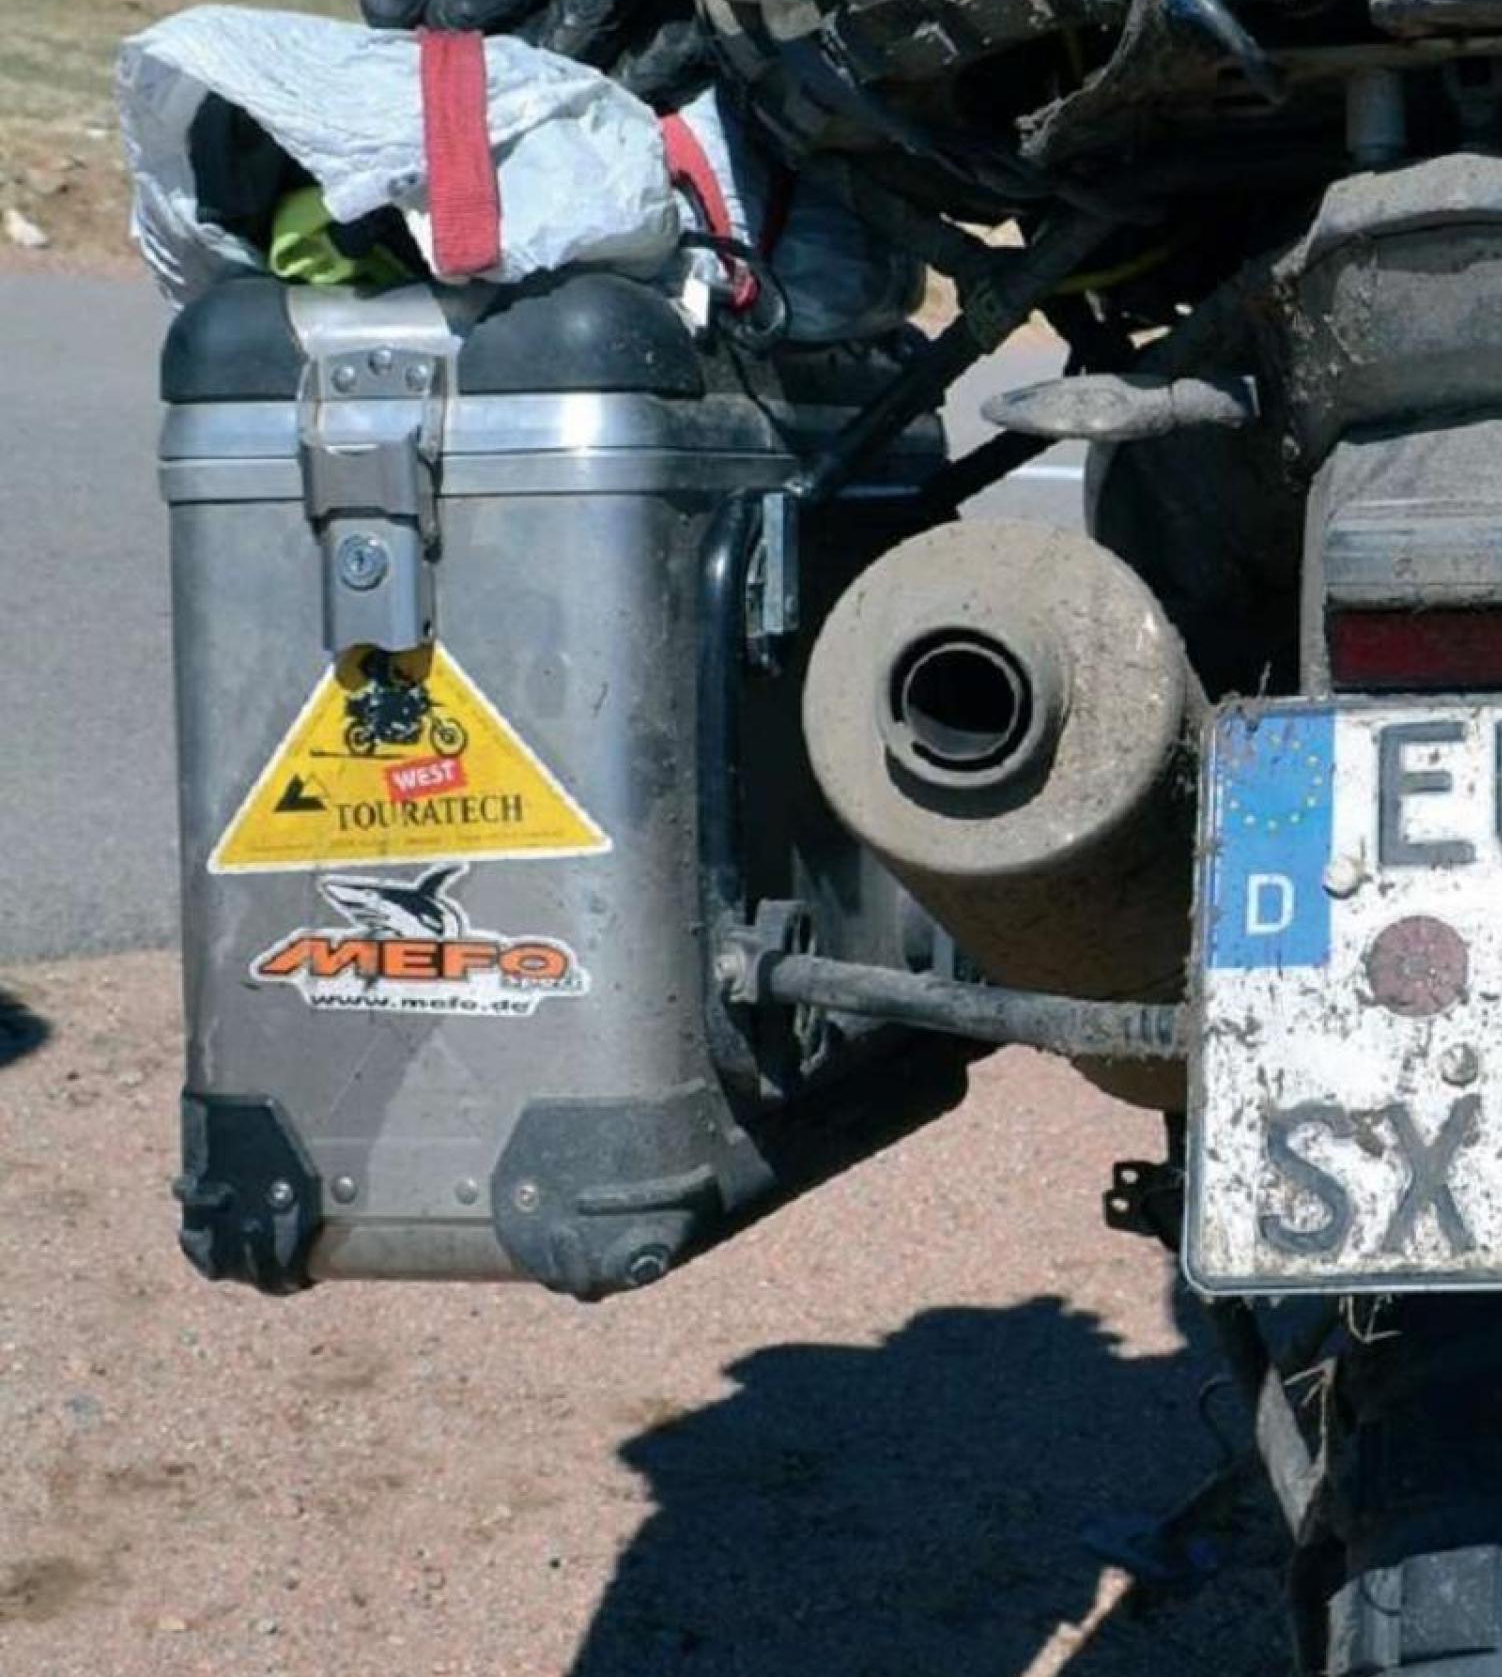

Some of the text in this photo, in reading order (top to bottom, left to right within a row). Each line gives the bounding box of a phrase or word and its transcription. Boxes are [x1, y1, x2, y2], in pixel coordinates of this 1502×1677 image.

[391, 757, 458, 792] WEST
[334, 792, 524, 833] TOURATECH
[1245, 872, 1296, 936] D
[254, 936, 570, 980] MEFO
[308, 990, 532, 1012] www.mefo.de
[1258, 1092, 1483, 1256] SX
